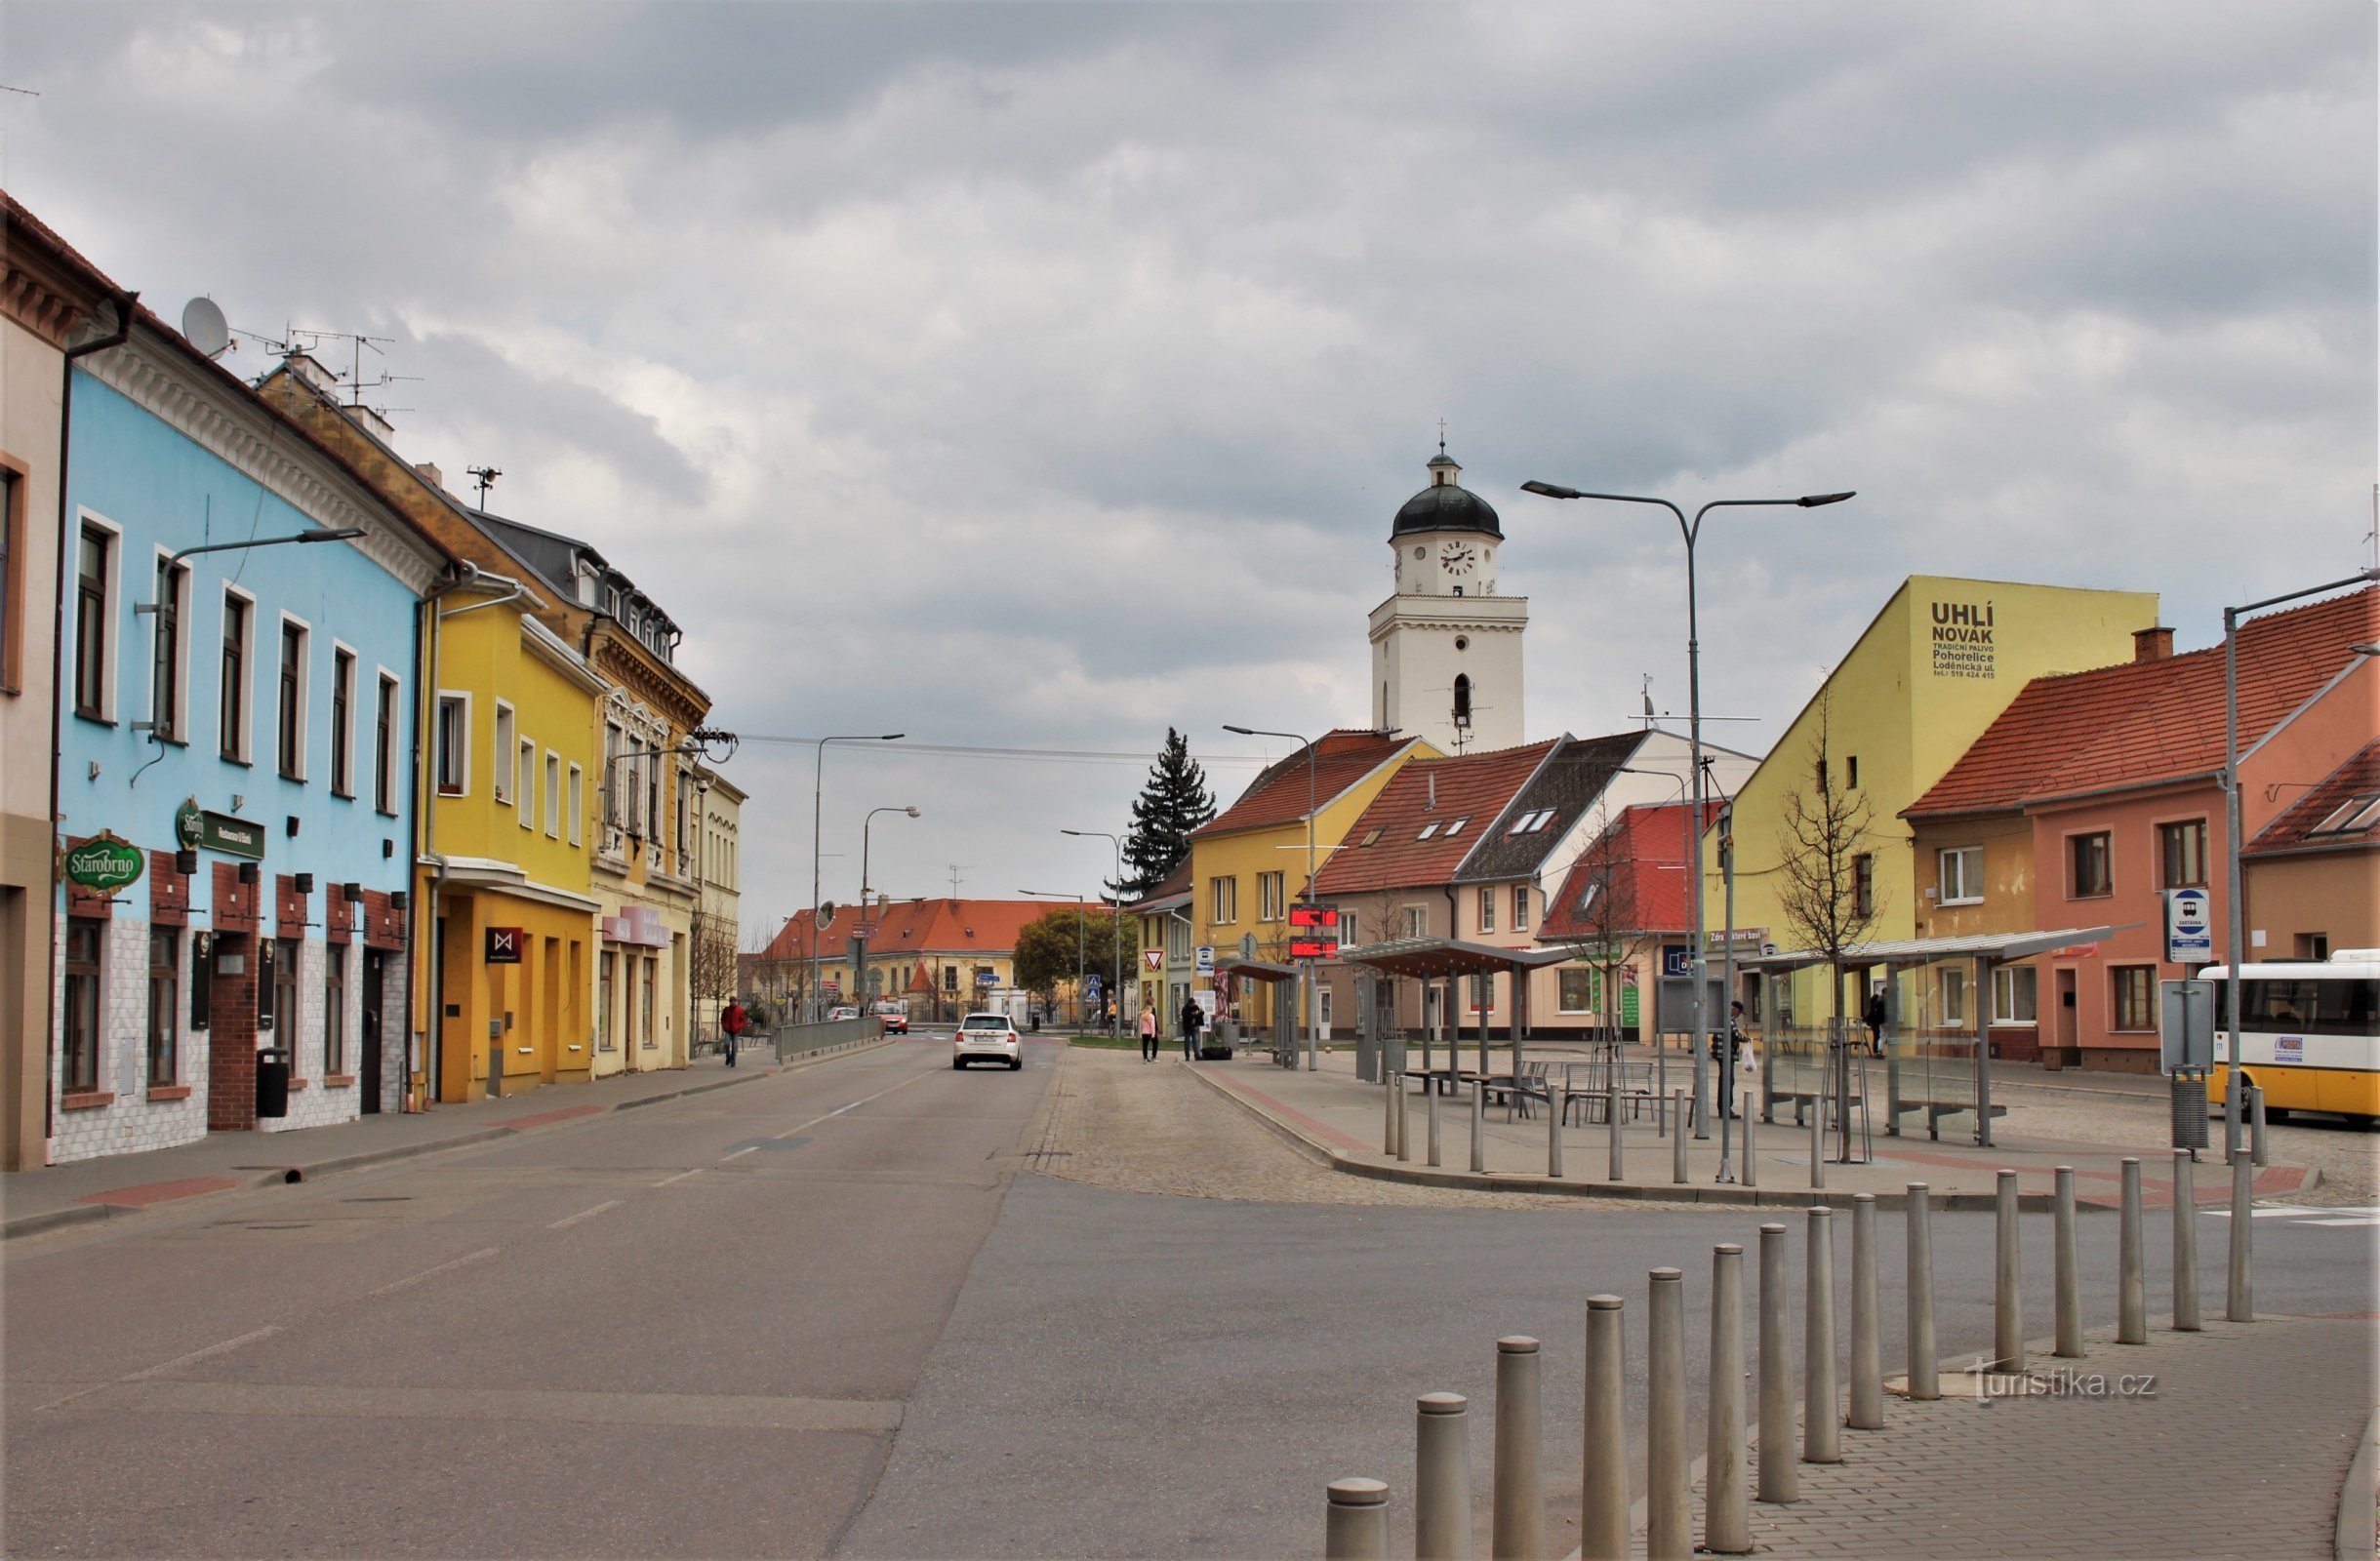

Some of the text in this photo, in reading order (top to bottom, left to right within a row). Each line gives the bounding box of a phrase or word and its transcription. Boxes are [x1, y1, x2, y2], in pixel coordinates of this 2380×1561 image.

[1931, 600, 1994, 627] UHLÍ
[1932, 625, 1993, 644] NOVÁK
[71, 850, 134, 878] Starobrno
